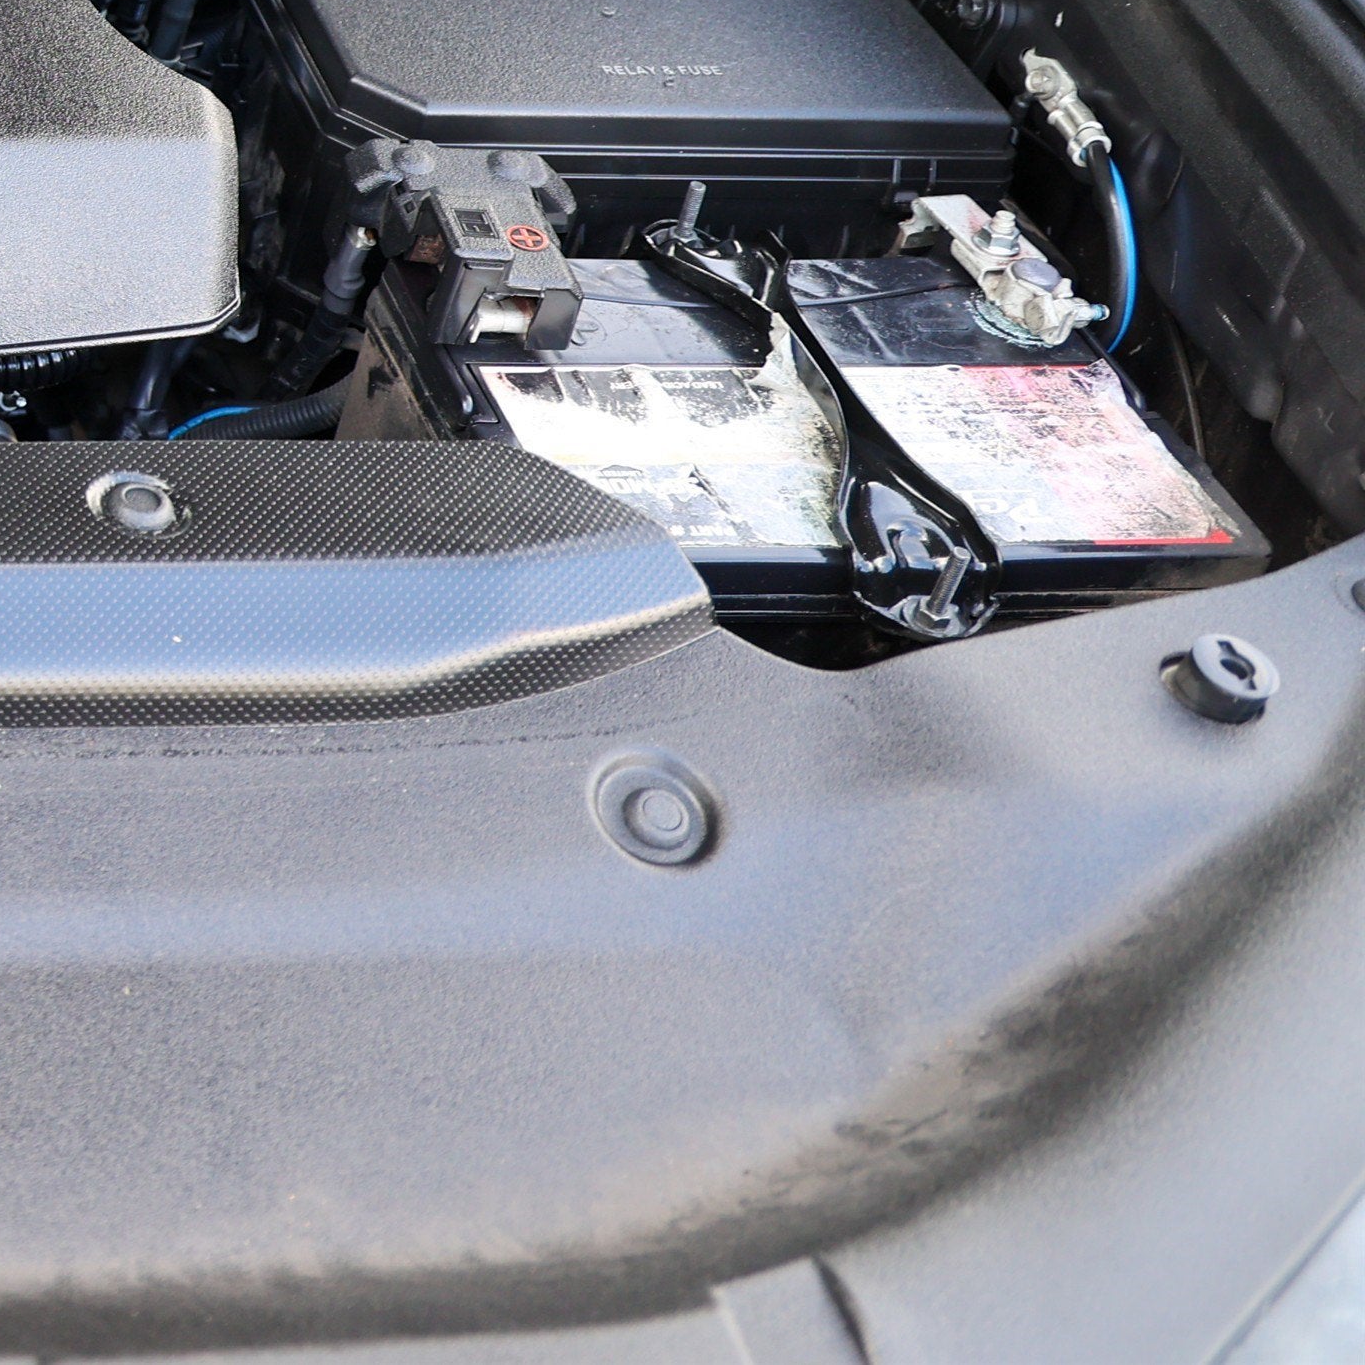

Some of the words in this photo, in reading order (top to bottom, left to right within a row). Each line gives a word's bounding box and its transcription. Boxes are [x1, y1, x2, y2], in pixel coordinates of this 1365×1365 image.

[602, 65, 656, 75] RELAY
[661, 65, 675, 75] &
[678, 65, 723, 75] FUSE
[660, 381, 691, 390] ACID
[692, 381, 725, 390] LEAD
[689, 524, 737, 537] PART
